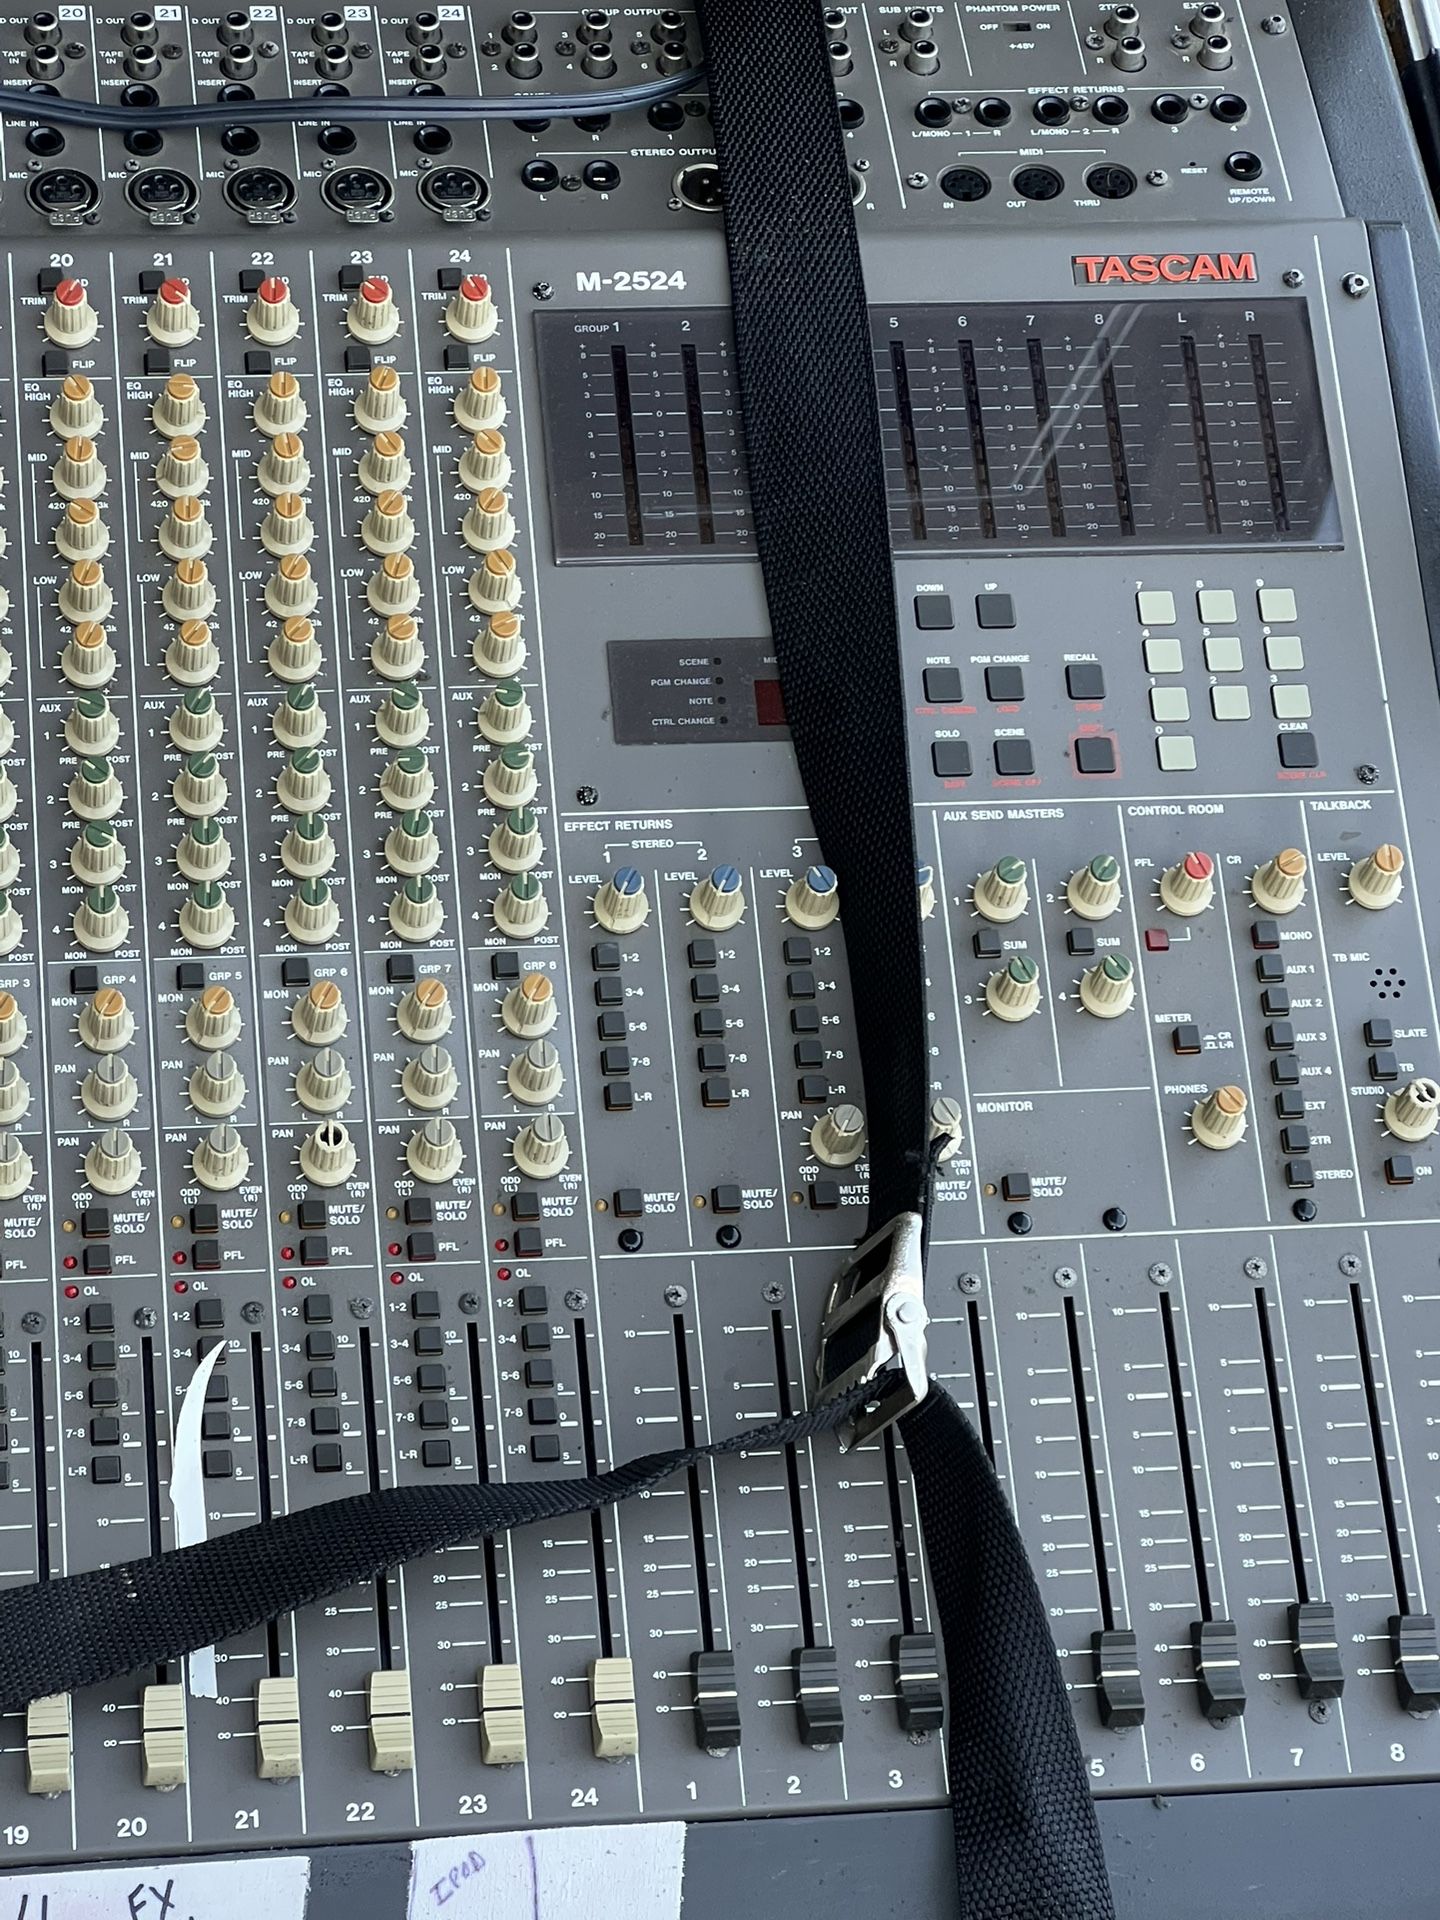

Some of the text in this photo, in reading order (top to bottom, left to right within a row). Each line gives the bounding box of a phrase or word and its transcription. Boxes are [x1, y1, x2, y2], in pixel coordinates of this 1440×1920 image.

[61, 7, 85, 19] 20
[159, 7, 180, 19] 21
[252, 7, 276, 19] 22
[346, 7, 370, 19] 23
[440, 7, 463, 19] 24
[965, 4, 1061, 13] PHANTOM POWER
[979, 23, 999, 31] OFF
[1027, 85, 1125, 95] EFFECT RETURNS
[911, 129, 951, 138] L/MONO
[993, 129, 1002, 137] R
[1030, 128, 1070, 136] L/MONO
[1082, 127, 1091, 135] 2
[1019, 148, 1044, 156] MIDI
[107, 171, 127, 179] MIC
[1229, 187, 1270, 196] REMOTE
[942, 199, 1101, 209] IN OUT THRU
[1227, 195, 1276, 204] UP/DOWN
[49, 253, 74, 268] 20
[153, 252, 173, 267] 21
[251, 251, 275, 266] 22
[350, 250, 374, 265] 23
[448, 249, 472, 263] 24
[1074, 253, 1258, 284] TASCAM
[576, 270, 688, 292] M-2524
[121, 295, 148, 305] TRIM
[574, 310, 1255, 333] GROUP 1 2 5 6 7 8 L R
[173, 358, 197, 368] FLIP
[126, 381, 142, 391] EQ
[126, 390, 153, 400] HIGH
[129, 451, 150, 460] MID
[136, 573, 161, 583] LOW
[916, 582, 998, 592] DOWN UP
[1135, 578, 1264, 590] 7 8 9
[1142, 626, 1272, 638] 4 5 6
[678, 658, 710, 667] SCENE
[926, 656, 951, 665] NOTE
[970, 654, 1030, 664] PGM CHANGE
[1063, 653, 1099, 662] RECALL
[650, 677, 712, 687] PGM CHANGE
[1149, 677, 1156, 686] 1
[1209, 675, 1218, 685] 2
[1269, 674, 1278, 683] 3
[143, 700, 166, 710] AUX
[688, 697, 714, 705] NOTE
[651, 716, 715, 726] CTRL CHANGE
[1154, 725, 1164, 735] 0
[1278, 722, 1309, 731] CLEAR
[934, 729, 961, 738] SOLO
[993, 727, 1025, 737] SCENE
[163, 753, 182, 762] PRE
[1127, 803, 1225, 817] CONTROL ROOM
[1309, 799, 1372, 811] TALKBACK
[943, 807, 1065, 822] AUX SEND MASTERS
[563, 818, 674, 832] EFFECT RETURNS
[631, 838, 675, 849] STEREO
[696, 848, 708, 861] 2
[791, 845, 803, 858] 3
[602, 850, 611, 864] 1
[1133, 855, 1242, 867] PFL CR
[1316, 852, 1351, 862] LEVEL
[759, 868, 794, 879] LEVEL
[568, 874, 603, 884] LEVEL
[1279, 930, 1313, 941] MONO
[220, 945, 246, 955] POST
[1002, 940, 1028, 950] SUM
[170, 947, 193, 956] MON
[621, 952, 640, 962] 1-2
[1332, 952, 1371, 963] TB MIC
[1285, 964, 1315, 974] AUX 1
[208, 971, 243, 981] GRP 5
[625, 987, 644, 997] 3-4
[1290, 998, 1324, 1008] AUX 2
[1154, 1013, 1192, 1024] METER
[628, 1021, 648, 1032] 5-6
[1217, 1031, 1232, 1040] CR
[1295, 1031, 1328, 1042] AUX 3
[1393, 1028, 1428, 1039] SLATE
[1218, 1040, 1235, 1049] L-R
[161, 1059, 183, 1070] PAN
[631, 1056, 651, 1067] 7-8
[1300, 1066, 1333, 1076] AUX 4
[1398, 1062, 1415, 1072] TB
[1163, 1083, 1209, 1095] PHONES
[1350, 1085, 1385, 1096] STUDIO
[634, 1091, 653, 1102] L-R
[976, 1100, 1034, 1113] MONITOR
[1304, 1100, 1326, 1111] EXT
[1309, 1135, 1332, 1145] 2TR
[1314, 1169, 1354, 1180] STEREO
[1415, 1166, 1433, 1176] ON
[1030, 1176, 1067, 1187] MUTE/
[1031, 1186, 1064, 1198] SOLO
[221, 1207, 259, 1221] MUTE/
[221, 1218, 254, 1230] SOLO
[223, 1250, 245, 1261] PFL
[192, 1281, 209, 1291] OL
[649, 1628, 663, 1638] 30
[652, 1670, 667, 1680] 40
[2, 1742, 1406, 1845] 19 20 21 22 23 24 1 2 3 5 6 7 8
